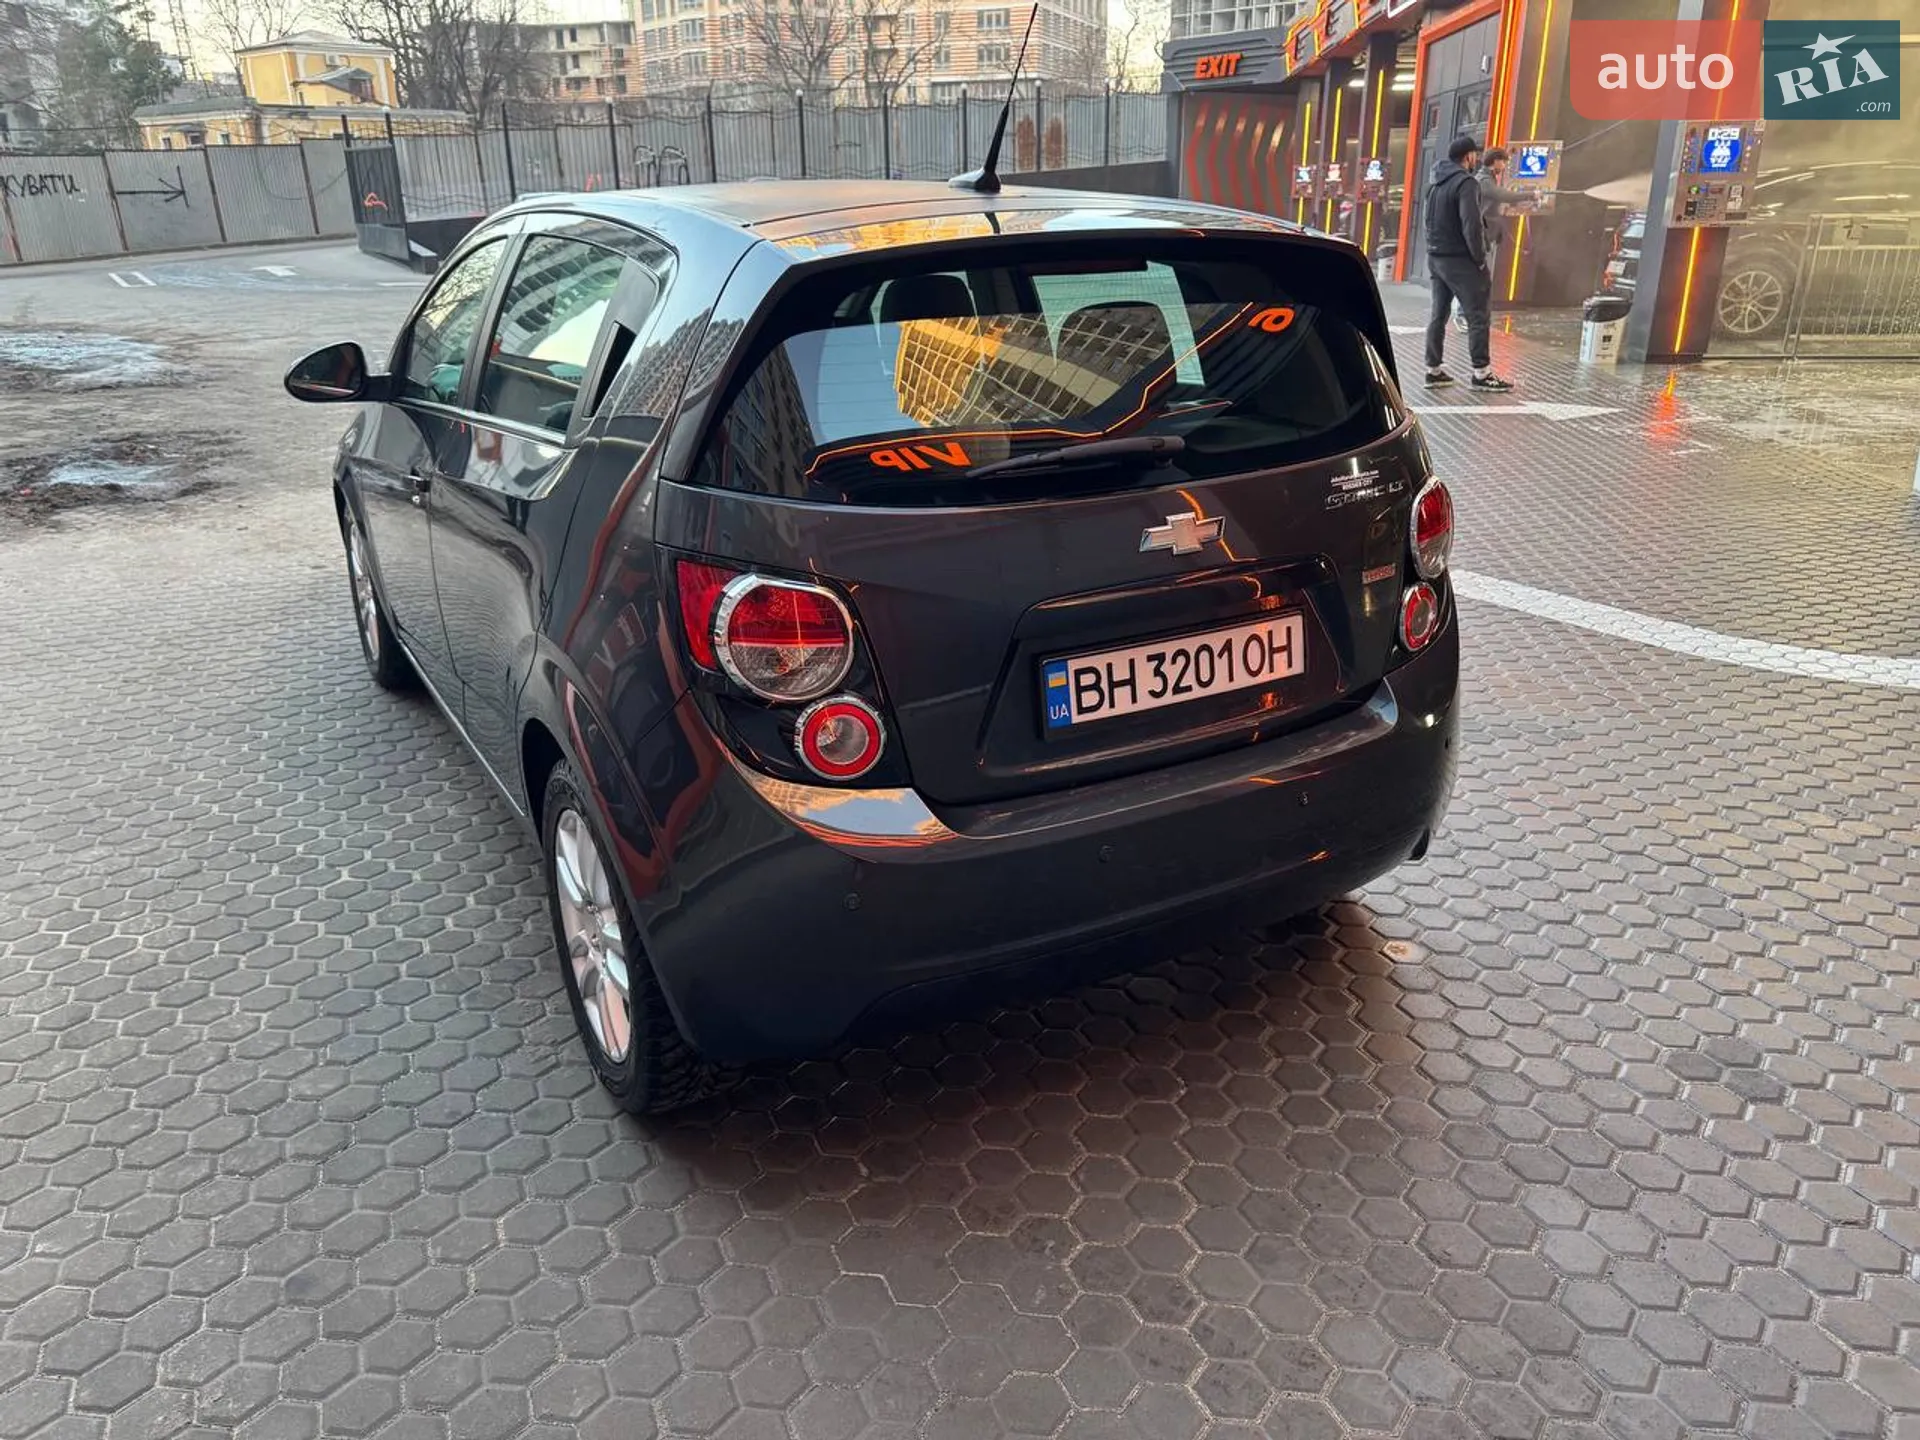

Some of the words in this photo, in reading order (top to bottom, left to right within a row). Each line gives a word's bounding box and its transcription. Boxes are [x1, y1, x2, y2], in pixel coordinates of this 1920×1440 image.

[1194, 53, 1243, 80] EXIT
[1074, 657, 1138, 716] BH
[1146, 637, 1235, 699] 3201
[1242, 625, 1294, 677] OH
[1050, 703, 1069, 720] UA
